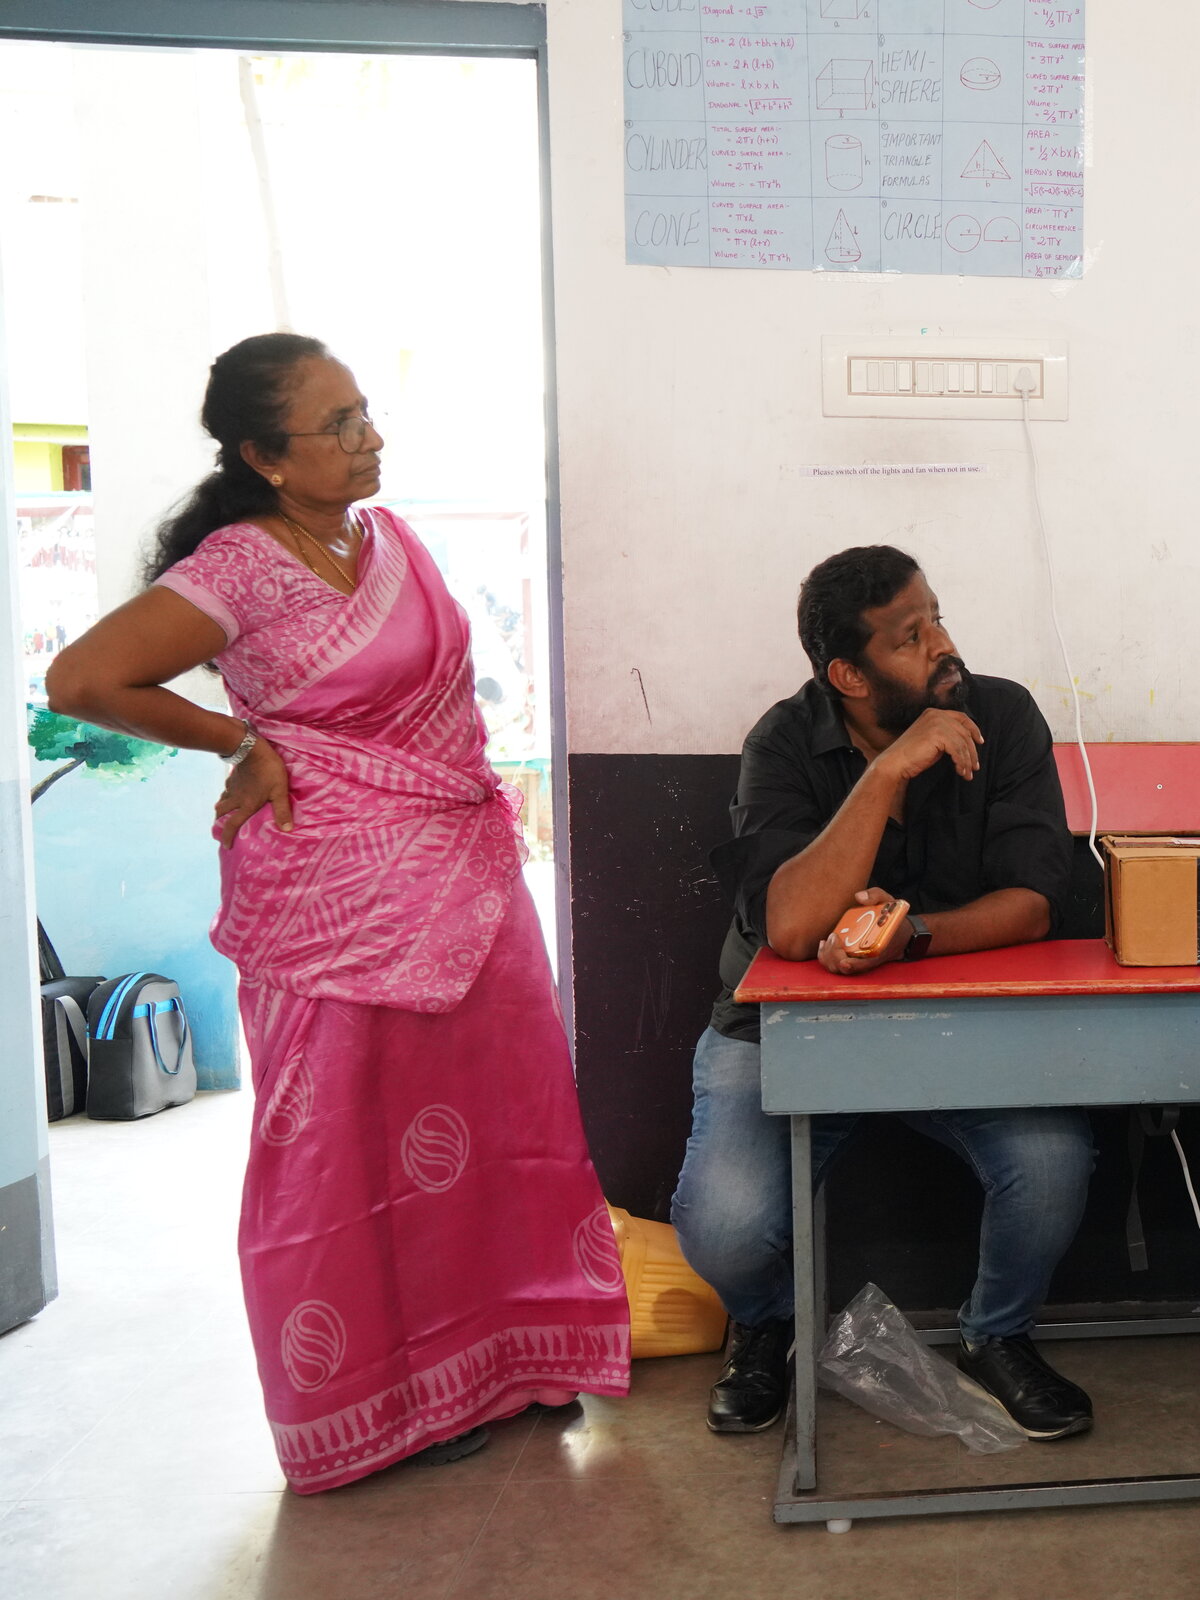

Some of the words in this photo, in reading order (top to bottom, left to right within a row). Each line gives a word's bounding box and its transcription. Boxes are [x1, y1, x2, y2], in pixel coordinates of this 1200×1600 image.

[881, 49, 936, 72] HEMI-
[627, 50, 702, 89] CUBOID
[881, 78, 941, 104] SPHERE
[1026, 129, 1050, 139] AREA
[626, 134, 708, 172] CYLINDER
[884, 155, 933, 167] TRIANGLE
[882, 176, 931, 187] FORMULAS
[1025, 206, 1042, 214] AREA
[635, 210, 700, 247] CONE
[884, 211, 942, 241] CIRCLE
[1025, 223, 1077, 231] CIRCUMFERENCE
[1025, 252, 1042, 260] AREA
[812, 468, 834, 476] Please
[835, 467, 857, 475] switch
[858, 466, 869, 475] off
[870, 467, 881, 475] the
[882, 467, 900, 476] lights
[902, 466, 914, 474] and
[915, 466, 927, 474] fan
